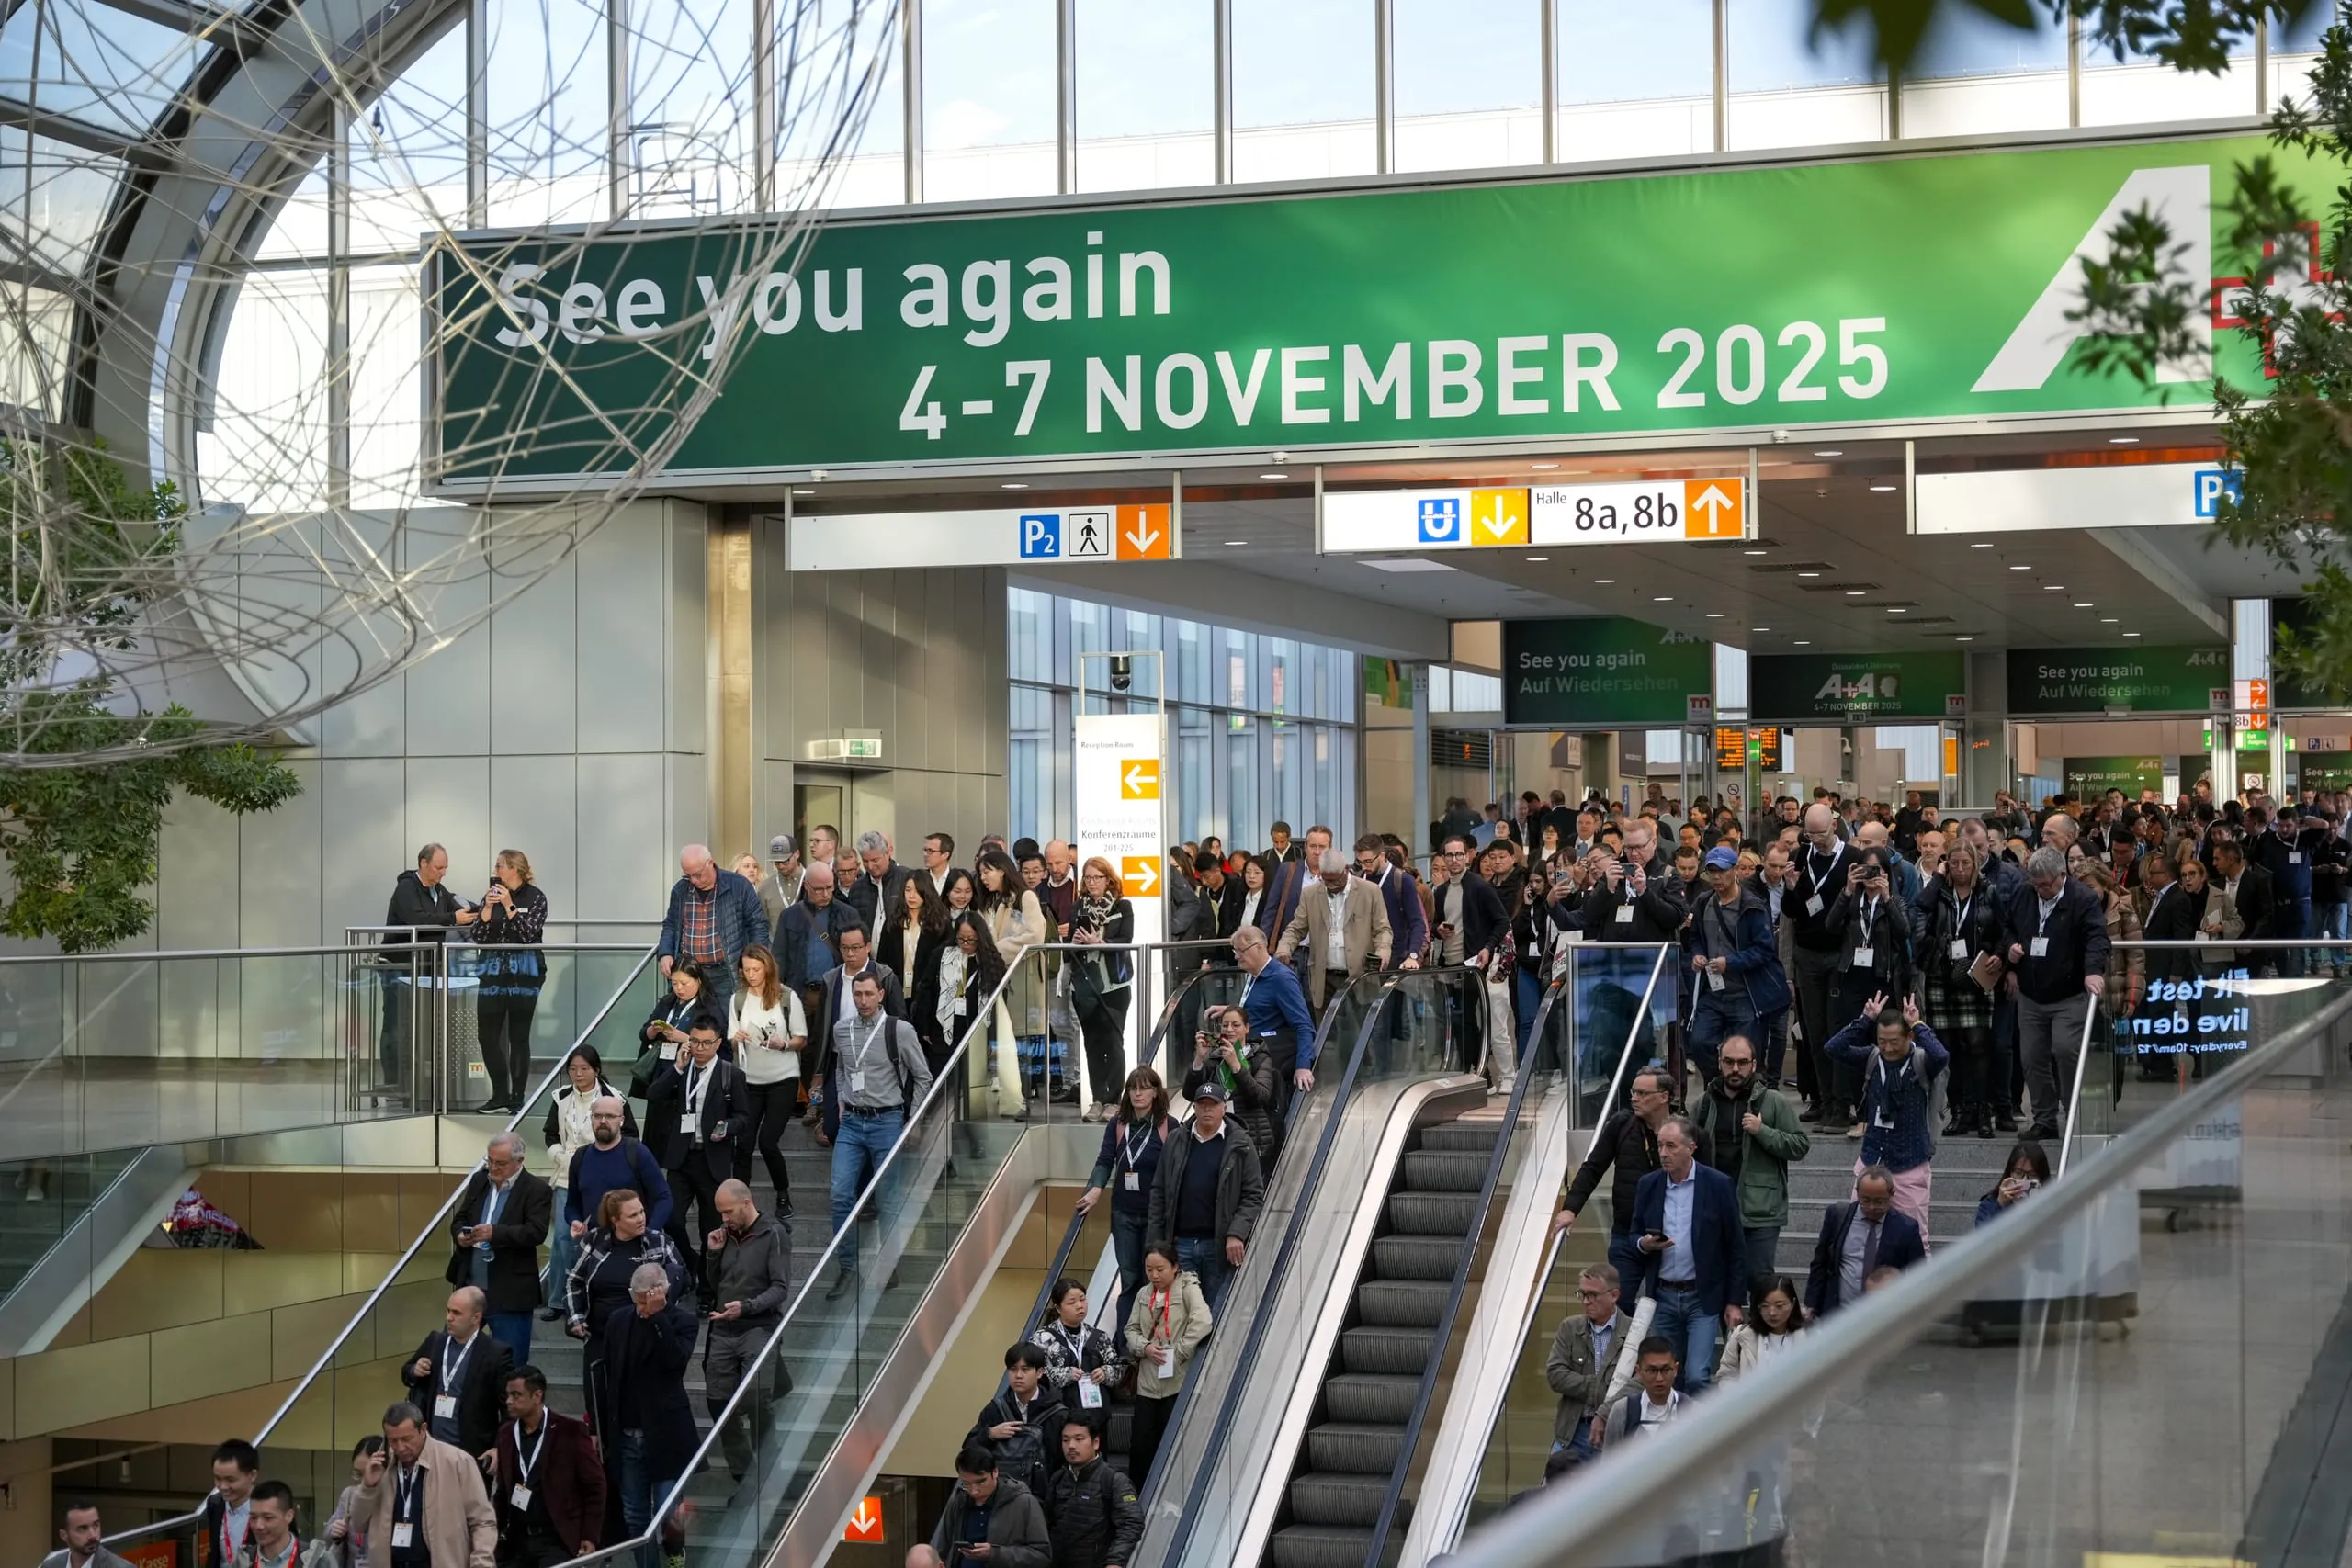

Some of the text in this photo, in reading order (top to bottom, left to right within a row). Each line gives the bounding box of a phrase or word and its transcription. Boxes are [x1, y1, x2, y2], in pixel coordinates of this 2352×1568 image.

[494, 231, 1171, 361] See you again
[899, 316, 1891, 441] 4-7 NOVEMBER 2025
[1535, 491, 1567, 506] Halle
[1574, 492, 1679, 535] 8a,8b
[1024, 515, 1056, 557] P2
[1519, 649, 1646, 671] See you again
[2038, 663, 2144, 681] See you again
[1519, 673, 1679, 694] Auf Wiedersehen
[2038, 683, 2172, 699] Auf Wiedersehen
[1814, 701, 1902, 712] 4-7 NOVEMBER 2025
[1080, 740, 1135, 750] Reception Room
[2069, 771, 2131, 782] See you again
[2304, 767, 2323, 776] See
